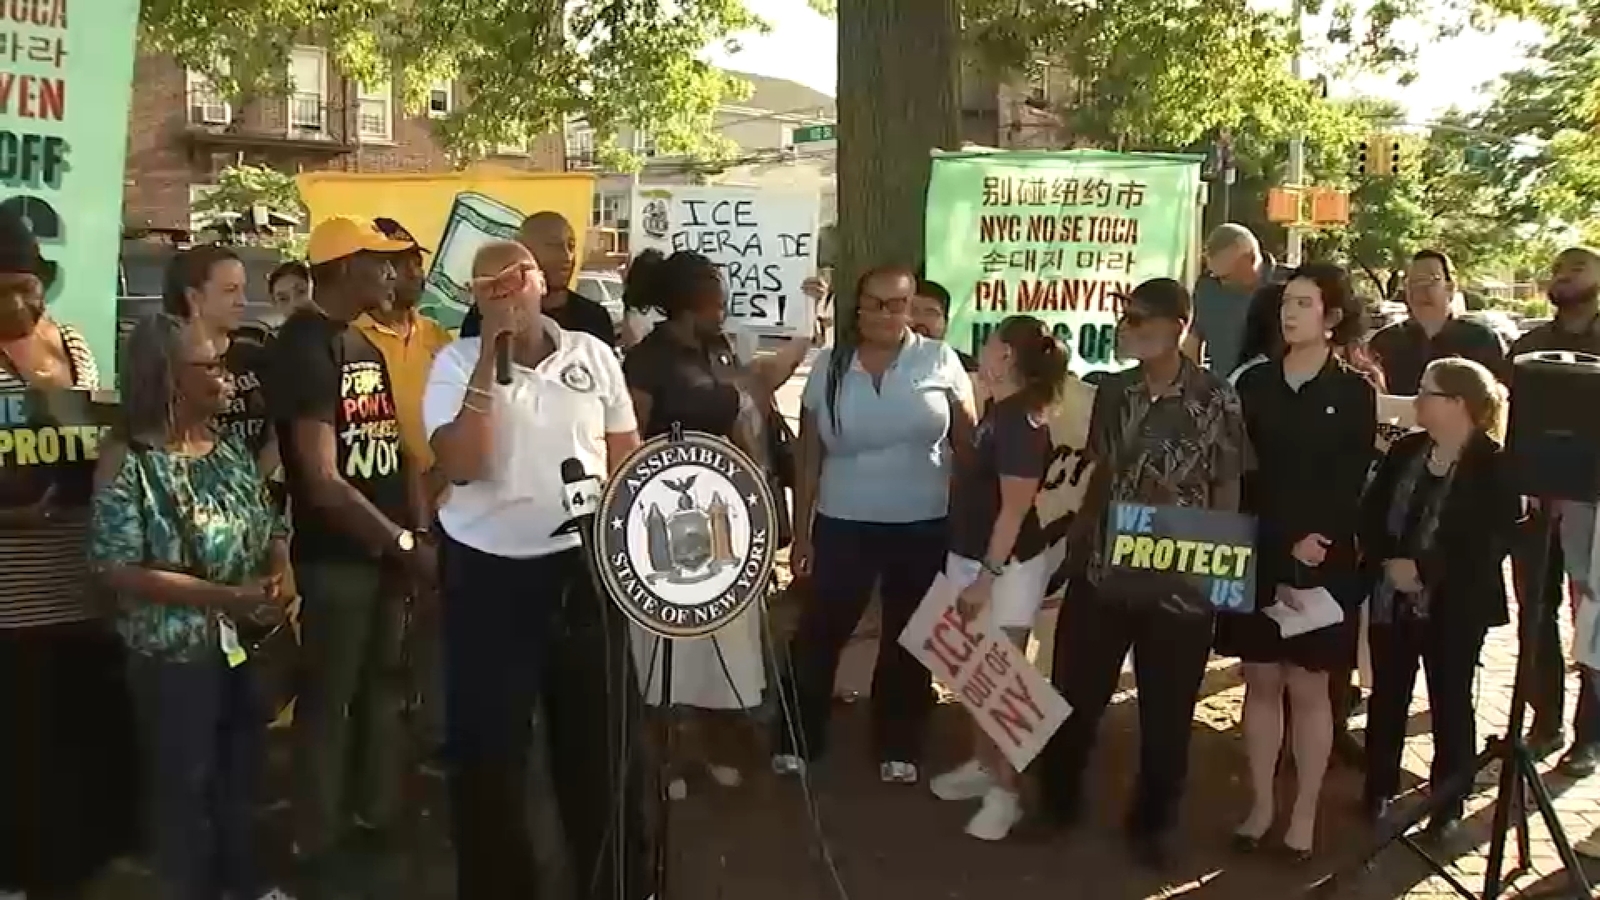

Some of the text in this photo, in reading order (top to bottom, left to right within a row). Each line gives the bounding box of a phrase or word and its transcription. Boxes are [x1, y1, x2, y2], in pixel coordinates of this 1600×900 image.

[982, 175, 1148, 210] 别碰纽约市
[681, 200, 758, 227] ICE
[979, 214, 1139, 245] NYC NO SE TOCA
[671, 230, 811, 258] FUERA DE
[980, 249, 1136, 274] 손대지 마라
[974, 279, 1008, 312] PA
[1078, 322, 1115, 364] OF
[0, 394, 26, 423] E
[0, 425, 112, 467] PROTE
[626, 446, 743, 495] ASSEMBLY
[572, 491, 584, 505] 4
[1117, 504, 1157, 533] WE
[1111, 534, 1252, 578] PROTECT
[612, 529, 766, 624] STATE OF NEW YORK
[1210, 579, 1246, 608] US
[923, 605, 985, 679] ICE
[961, 641, 1012, 709] OUT OF
[989, 673, 1046, 748] NY
